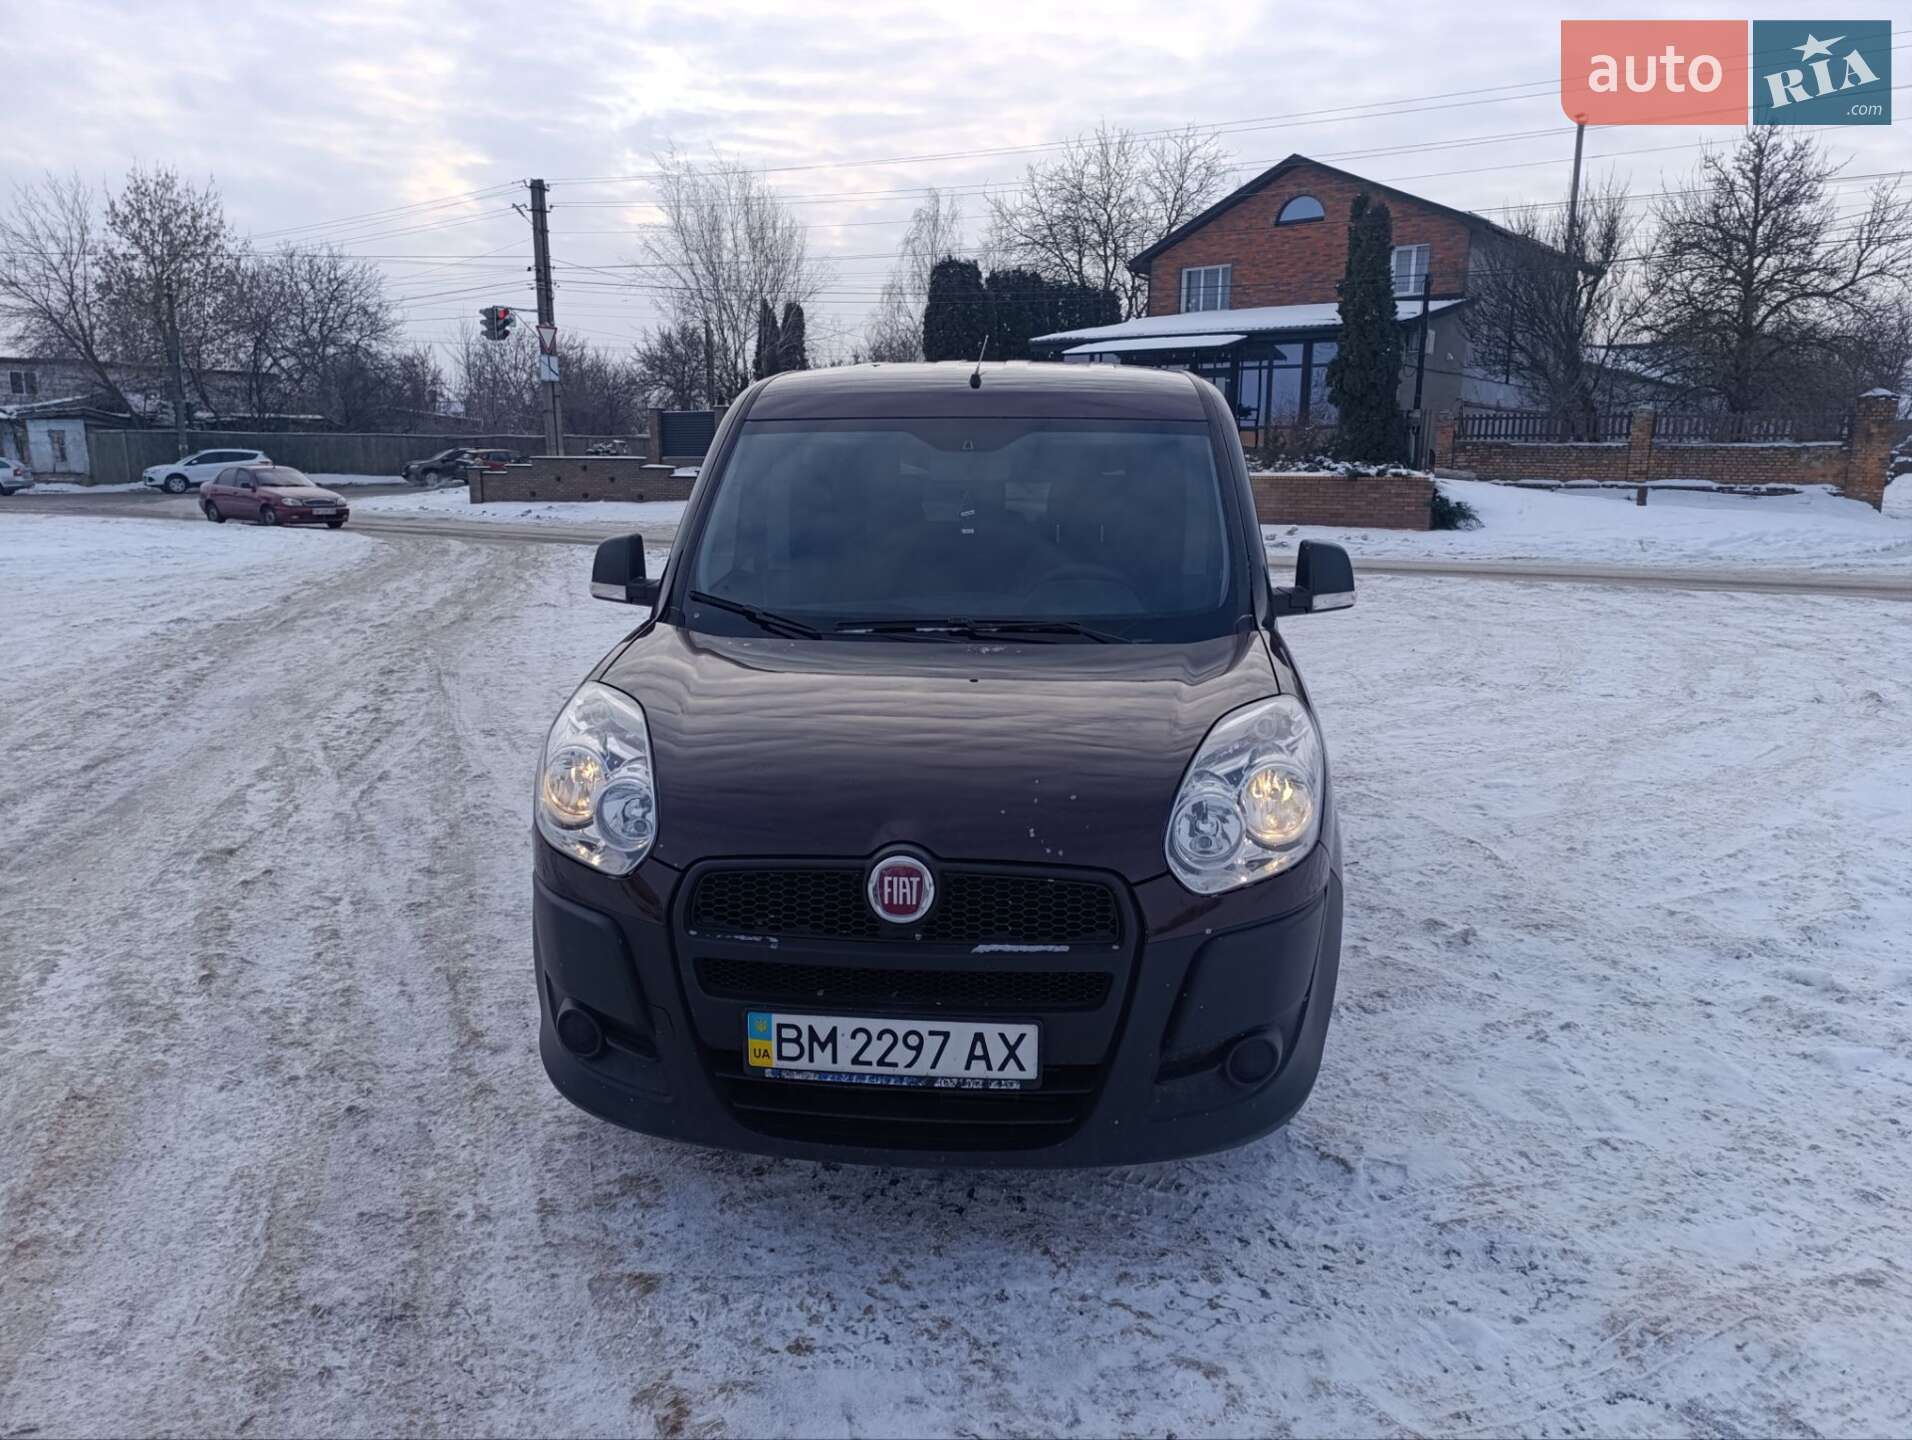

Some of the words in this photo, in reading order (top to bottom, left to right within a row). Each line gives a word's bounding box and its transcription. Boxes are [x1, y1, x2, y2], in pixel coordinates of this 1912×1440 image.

[883, 876, 921, 905] FIAT
[753, 1047, 771, 1060] UA
[775, 1022, 838, 1064] BM
[849, 1027, 951, 1070] 2297
[964, 1032, 1027, 1072] AX
